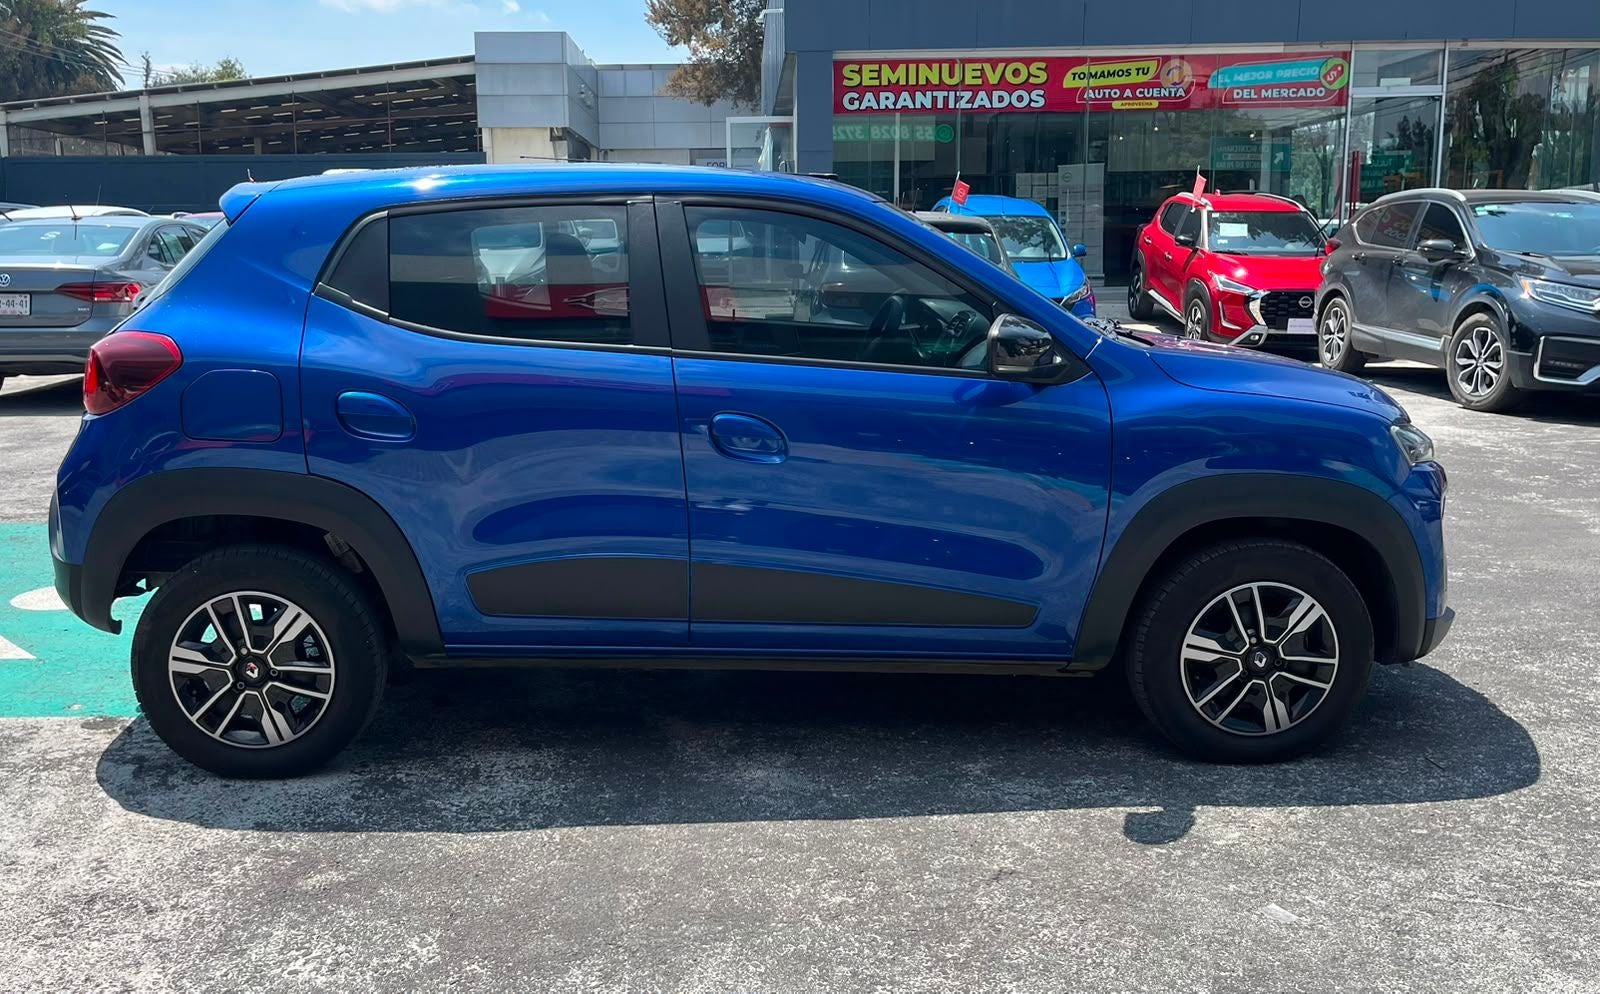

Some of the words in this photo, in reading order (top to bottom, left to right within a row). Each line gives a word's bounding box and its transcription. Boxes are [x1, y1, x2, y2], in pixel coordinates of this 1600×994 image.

[842, 61, 1049, 87] SEMINUEVOS
[1071, 68, 1132, 81] TOMAMOS
[1135, 66, 1150, 76] TU
[1218, 73, 1231, 83] EL
[1233, 70, 1273, 81] MEJOR
[1275, 66, 1320, 78] PRECIO
[842, 89, 1046, 111] GARANTIZADOS
[1083, 88, 1120, 99] AUTO
[1123, 88, 1133, 98] A
[1135, 87, 1186, 98] CUENTA
[1233, 89, 1258, 99] DEL
[1261, 87, 1326, 98] MERCADO
